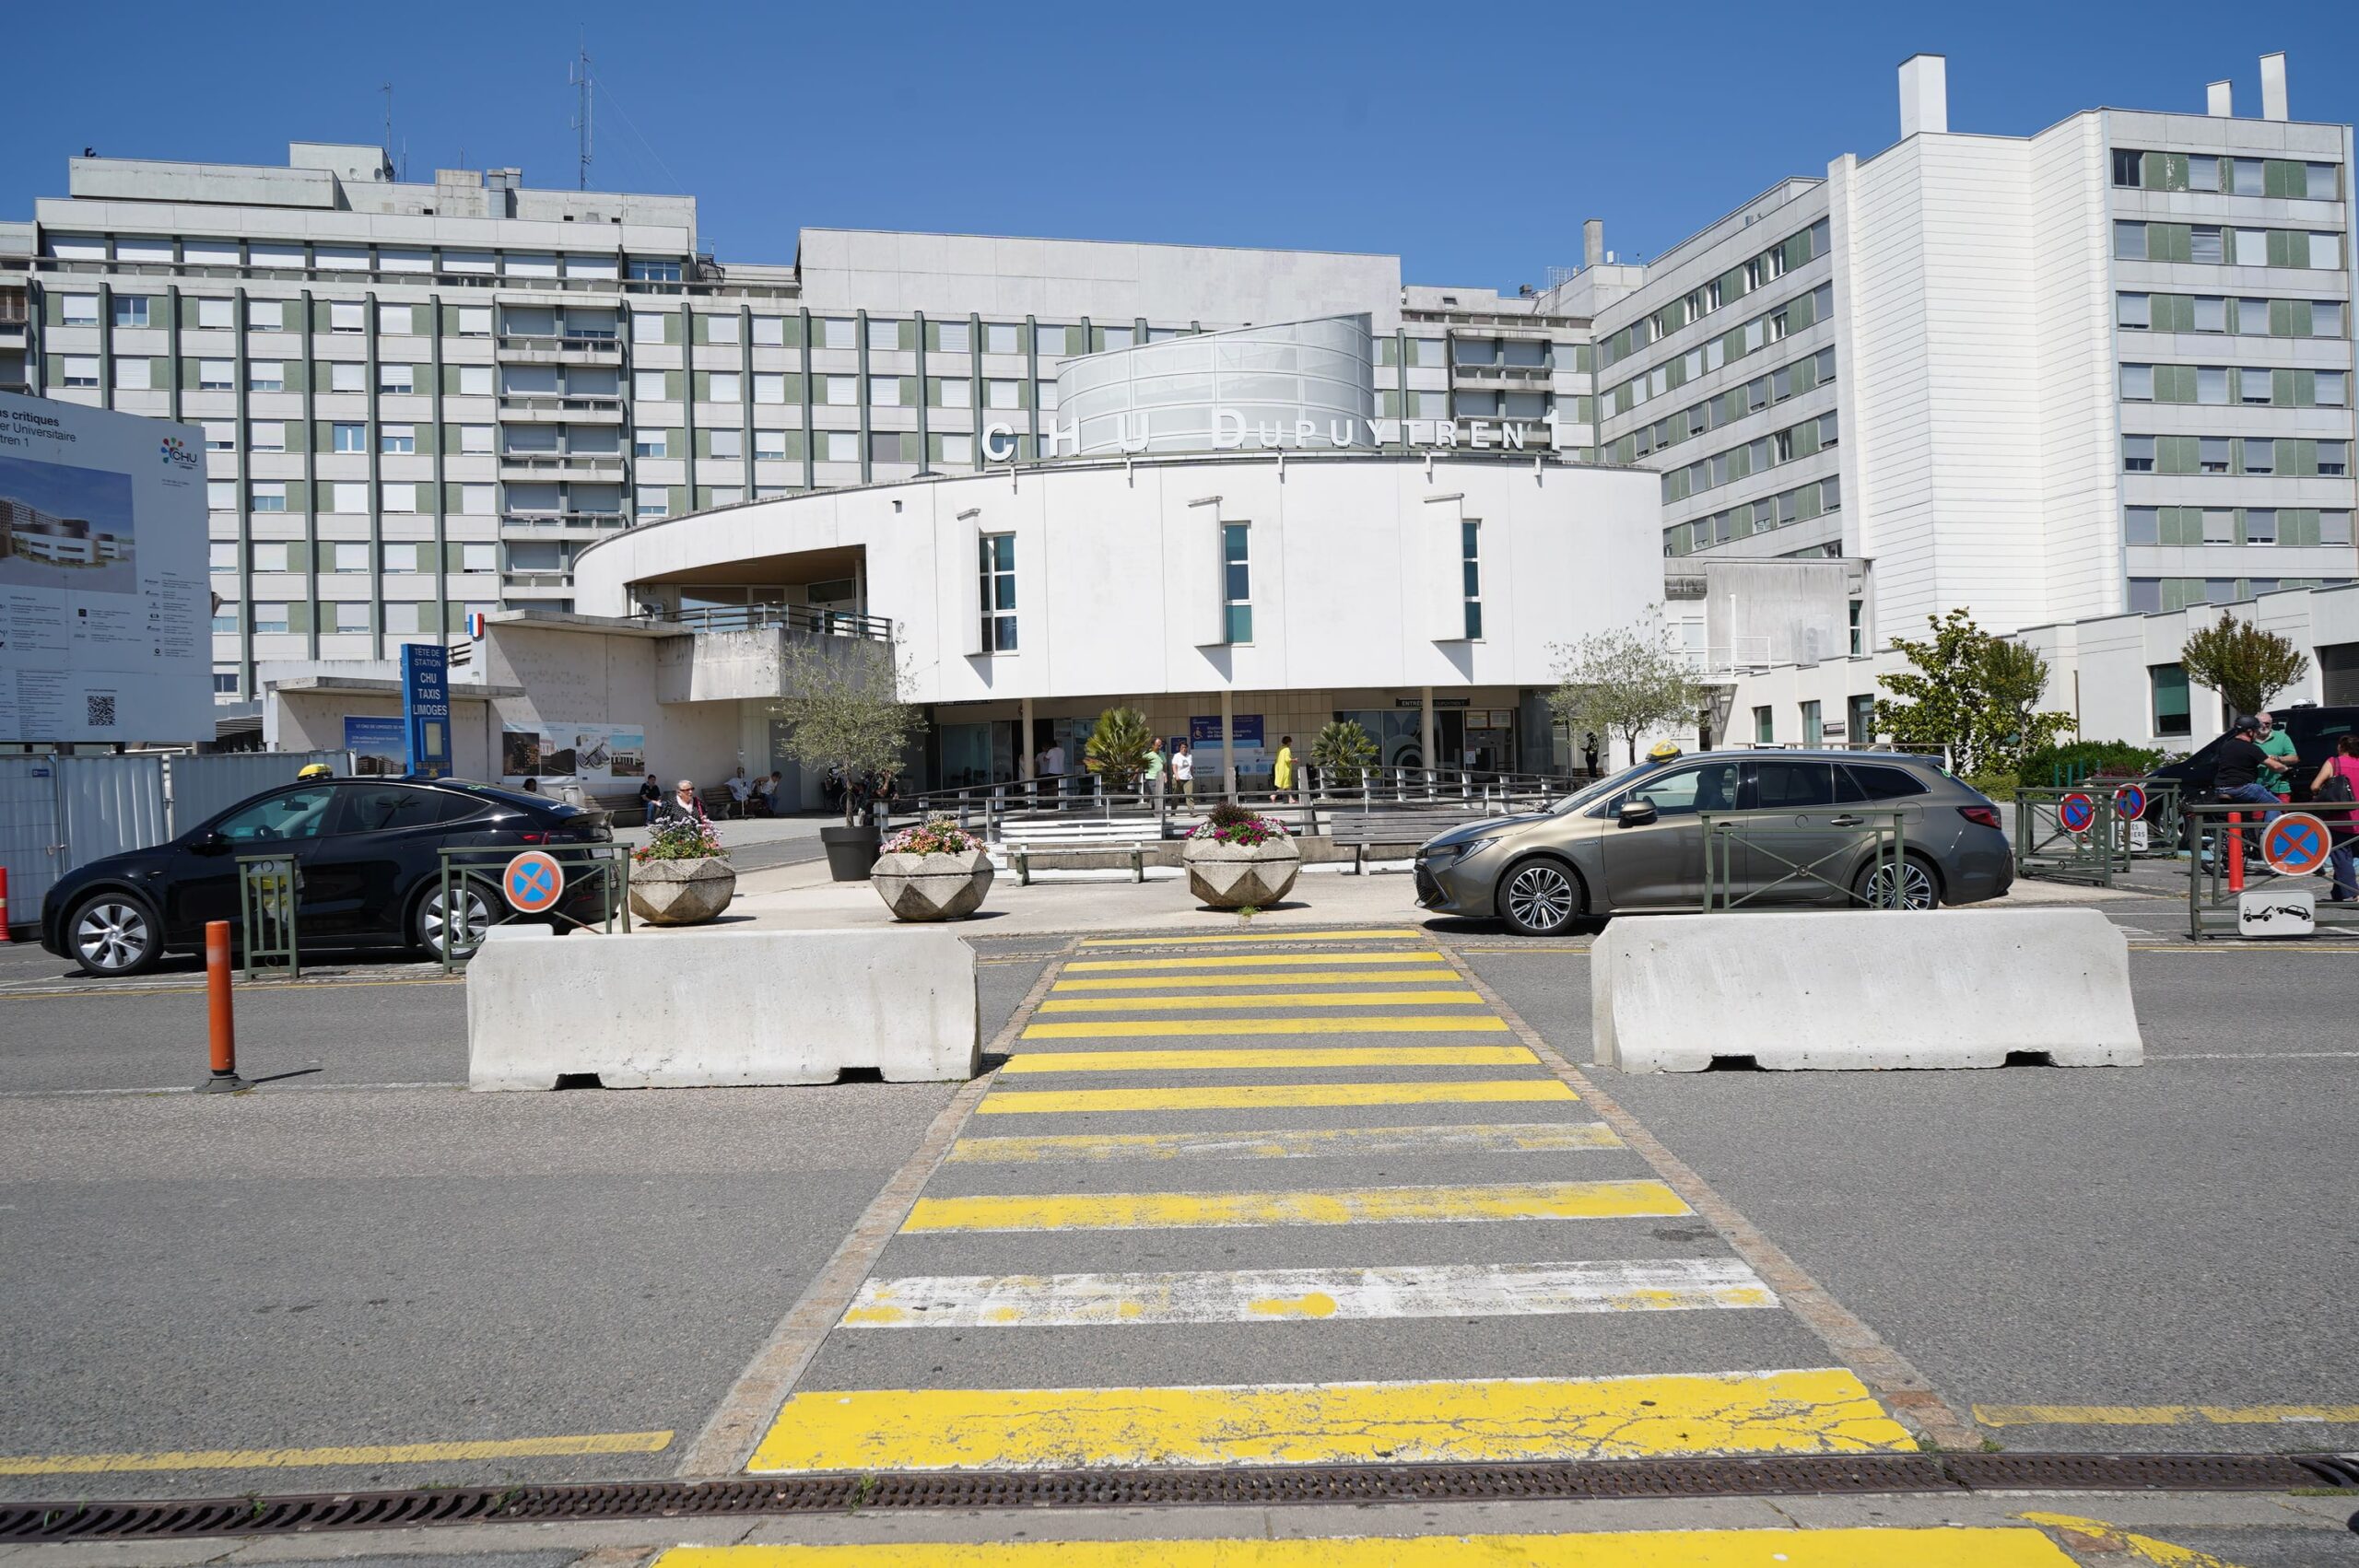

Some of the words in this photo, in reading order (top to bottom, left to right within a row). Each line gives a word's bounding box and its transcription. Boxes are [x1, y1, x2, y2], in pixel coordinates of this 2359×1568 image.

[12, 411, 60, 427] critiques
[13, 422, 76, 442] Universitaire
[981, 413, 1150, 462] CHU
[1542, 409, 1562, 451] 1
[24, 438, 29, 448] 1
[172, 451, 197, 463] CHU
[415, 647, 430, 656] TÊTE
[430, 649, 440, 657] DE
[414, 659, 441, 667] STATION
[420, 673, 437, 684] CHU
[417, 688, 440, 700] TAXIS
[413, 704, 448, 716] LIMOGES
